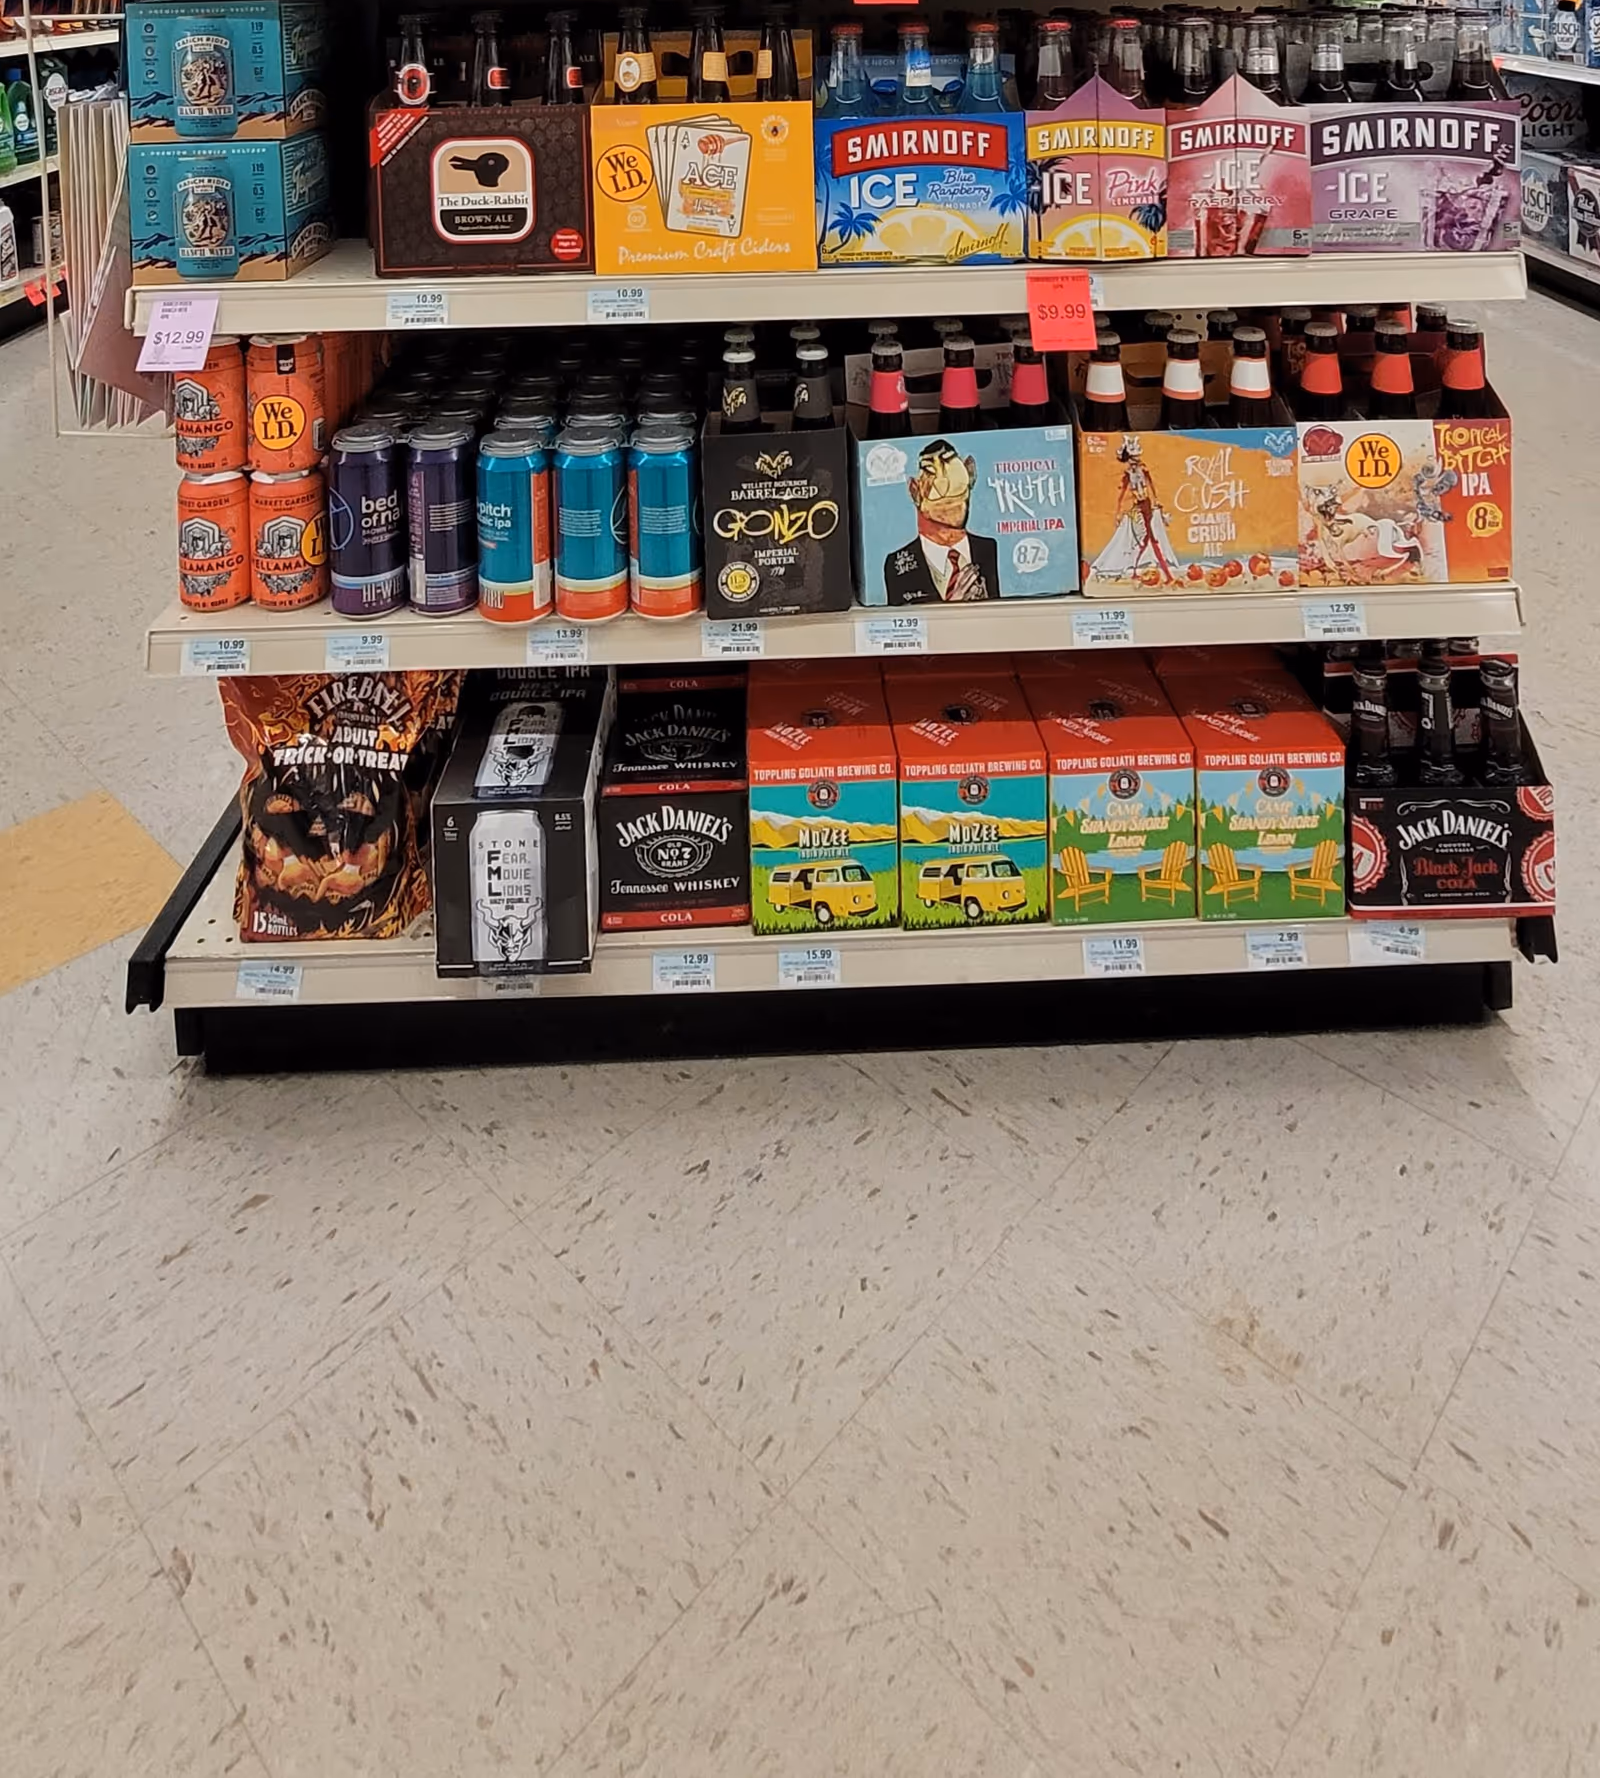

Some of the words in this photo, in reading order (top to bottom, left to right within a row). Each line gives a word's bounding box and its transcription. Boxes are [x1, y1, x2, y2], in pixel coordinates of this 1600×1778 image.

[1523, 123, 1575, 137] LIGHT
[848, 131, 991, 163] SMIRNOFF
[1039, 129, 1155, 153] SMIRNOFF
[1323, 122, 1500, 156] SMIRNOFF
[684, 163, 737, 190] ACE
[943, 169, 973, 184] Blue
[851, 174, 918, 208] ICE
[928, 182, 993, 202] Raspberry
[1045, 172, 1092, 204] ICE
[1107, 169, 1158, 196] Pink
[438, 196, 458, 206] The
[461, 195, 529, 206] Duck-Rabbit
[455, 215, 492, 224] BROWN
[495, 214, 513, 223] ALE
[1329, 209, 1398, 220] GRAPE
[618, 246, 689, 264] Premium
[694, 241, 735, 264] Craft
[741, 237, 791, 255] Ciders
[416, 294, 442, 303] 10.99
[1038, 304, 1085, 320] $9.99
[153, 331, 204, 345] $12.99
[262, 406, 293, 420] We
[262, 419, 297, 440] I.D.
[1362, 446, 1389, 461] We
[994, 460, 1057, 472] TROPICAL
[1357, 460, 1391, 478] I.D.
[731, 486, 818, 500] BARREL-AGED
[1462, 473, 1492, 497] IPA
[361, 495, 397, 512] bed
[990, 475, 1065, 518] TRUTH
[714, 501, 838, 544] GONZO
[997, 521, 1039, 533] IMPERIAL
[1042, 519, 1064, 530] IPA
[754, 548, 798, 558] IMPERIAL
[758, 557, 795, 565] PORTER
[732, 623, 757, 632] 21.99
[332, 725, 376, 746] ADULT
[754, 767, 796, 780] TOPPLING
[799, 766, 835, 778] GOLIATH
[838, 764, 877, 776] BREWING
[879, 764, 893, 774] CO.
[616, 812, 661, 848] JACK
[662, 805, 732, 844] DANIEL'S
[1399, 817, 1439, 850] JACK
[1443, 811, 1512, 849] DANIEL'S
[1414, 858, 1457, 876] Black
[1461, 858, 1498, 877] Jack
[610, 883, 669, 896] Tennessee
[675, 877, 739, 891] WHISKEY
[1436, 877, 1477, 889] COLA
[661, 912, 692, 922] COLA
[805, 950, 831, 959] 15.99
